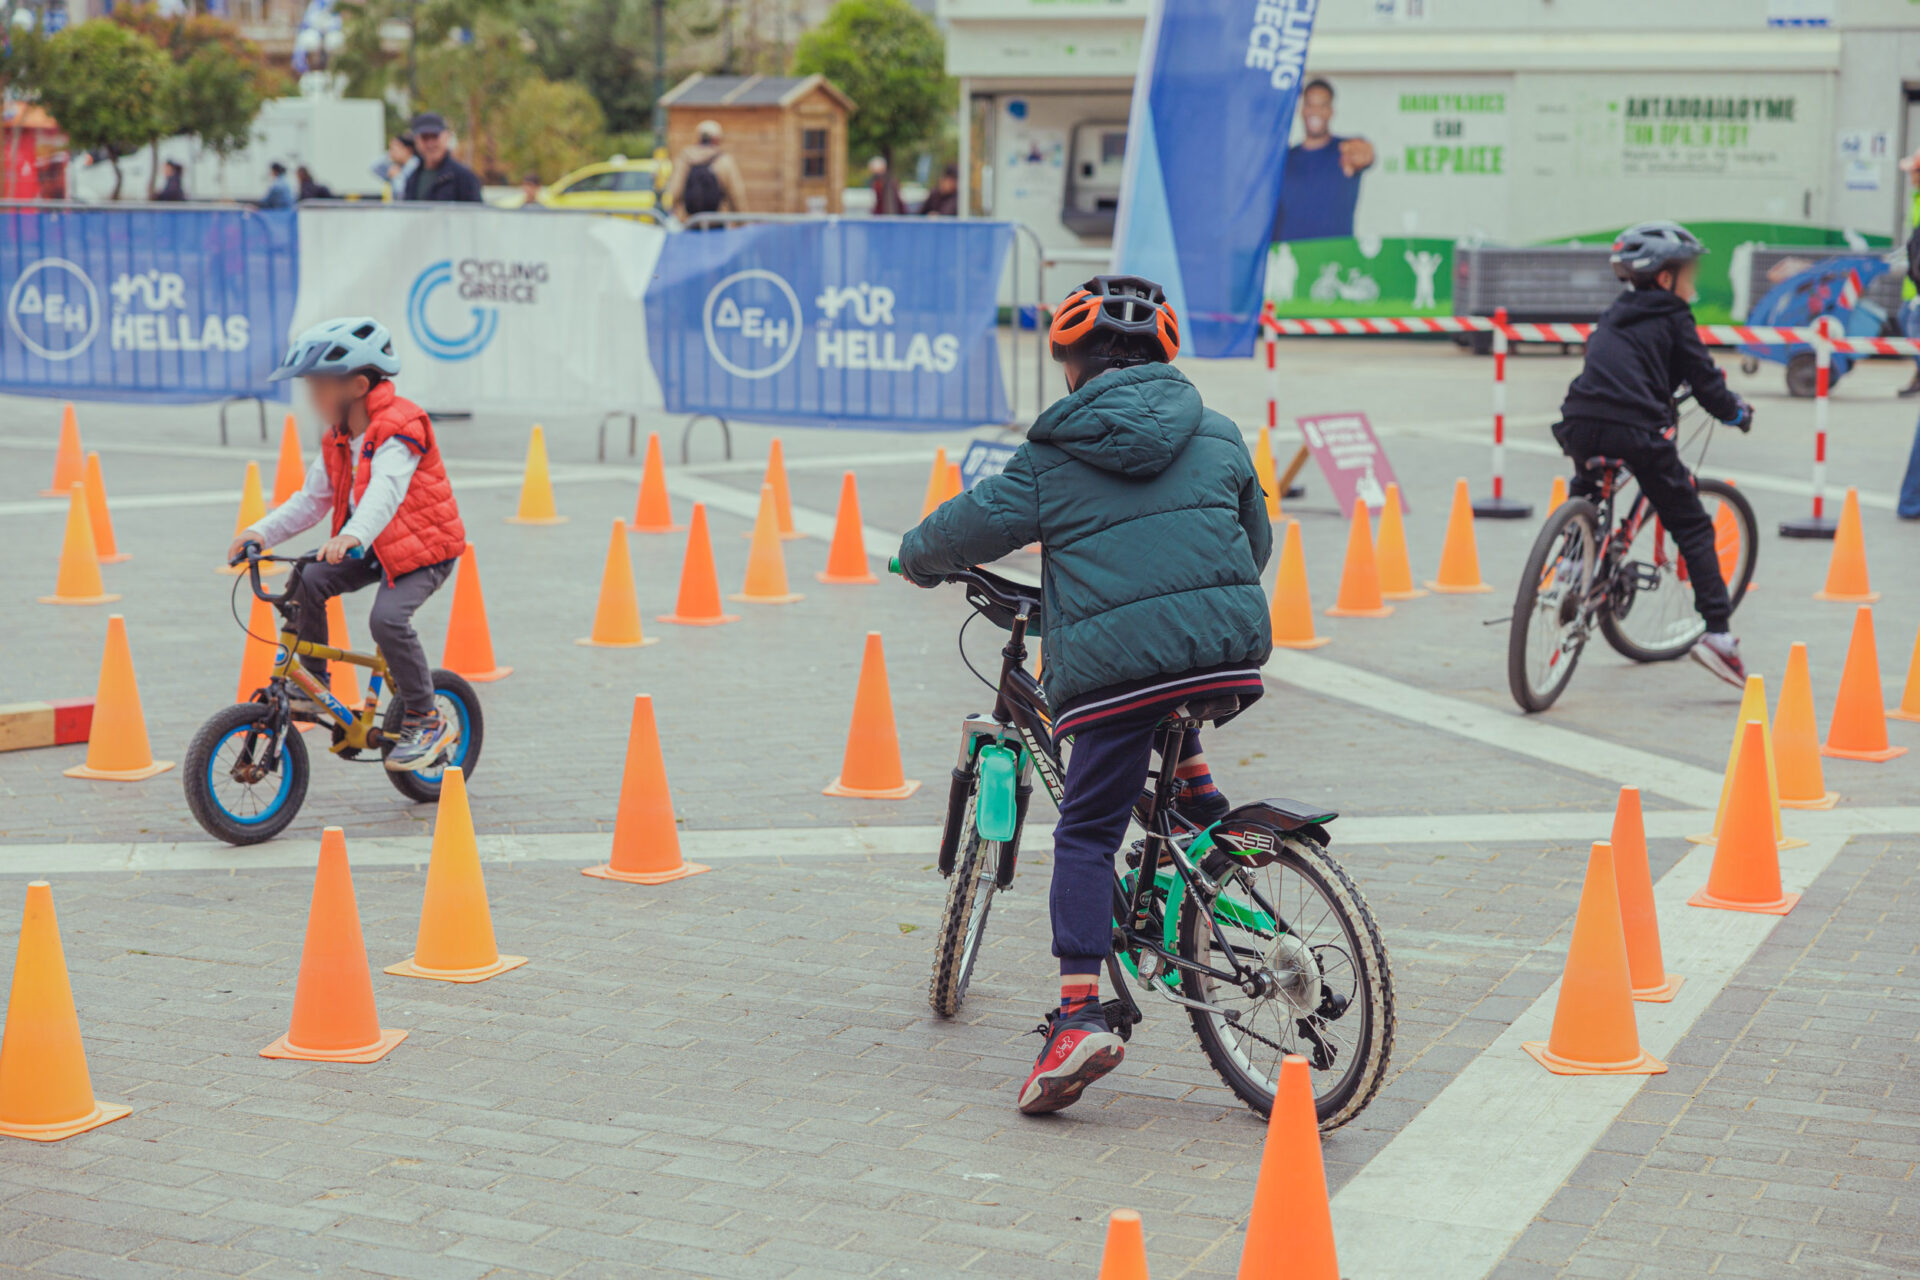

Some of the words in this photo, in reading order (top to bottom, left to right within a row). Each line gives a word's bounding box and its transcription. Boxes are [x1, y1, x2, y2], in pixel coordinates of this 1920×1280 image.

[1245, 0, 1287, 71] ECE
[458, 258, 549, 283] CYCLING
[458, 281, 537, 303] GREECE
[18, 284, 88, 332] ΔΕΗ
[715, 297, 789, 349] ΔΕΗ
[111, 313, 250, 352] HELLAS
[816, 330, 960, 374] HELLAS
